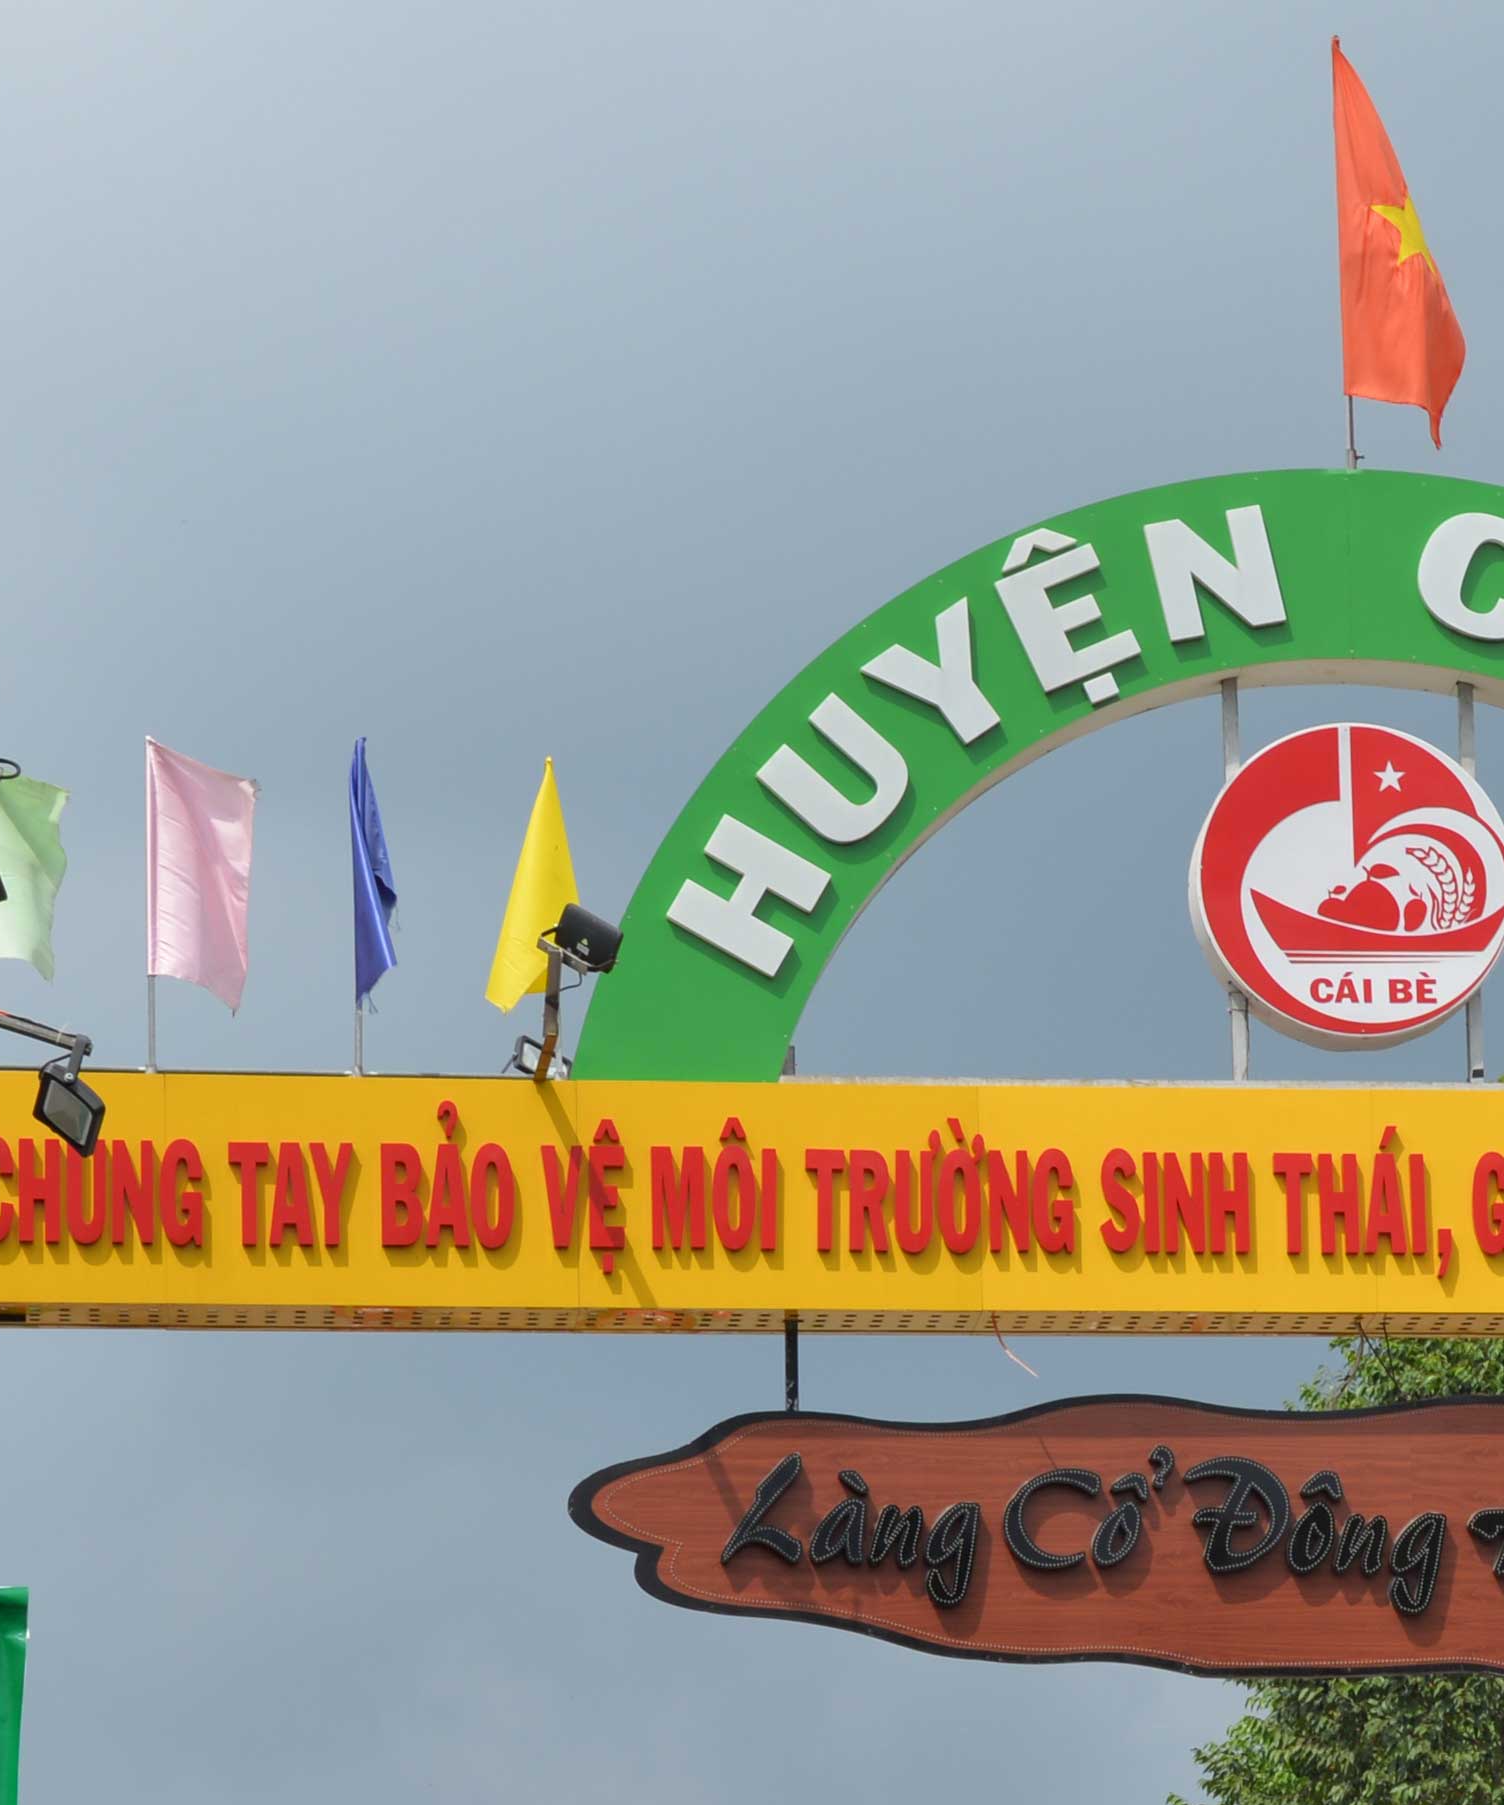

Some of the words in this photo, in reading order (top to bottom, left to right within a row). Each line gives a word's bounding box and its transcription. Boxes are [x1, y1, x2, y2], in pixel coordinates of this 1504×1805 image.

[666, 504, 1286, 979] HUYỆN
[1310, 968, 1381, 1005] CÁI
[1388, 968, 1437, 1004] BÈ
[228, 1140, 353, 1250] TAY
[380, 1099, 514, 1253] BẢO
[540, 1118, 625, 1276] VỆ
[650, 1117, 778, 1254] MÔI
[805, 1117, 1076, 1256] TRƯỜNG
[1100, 1148, 1250, 1255] SINH
[1272, 1126, 1454, 1280] THÁI,
[721, 1452, 980, 1608] Làng
[1004, 1444, 1174, 1570] Cổ
[1183, 1456, 1447, 1616] Đông
